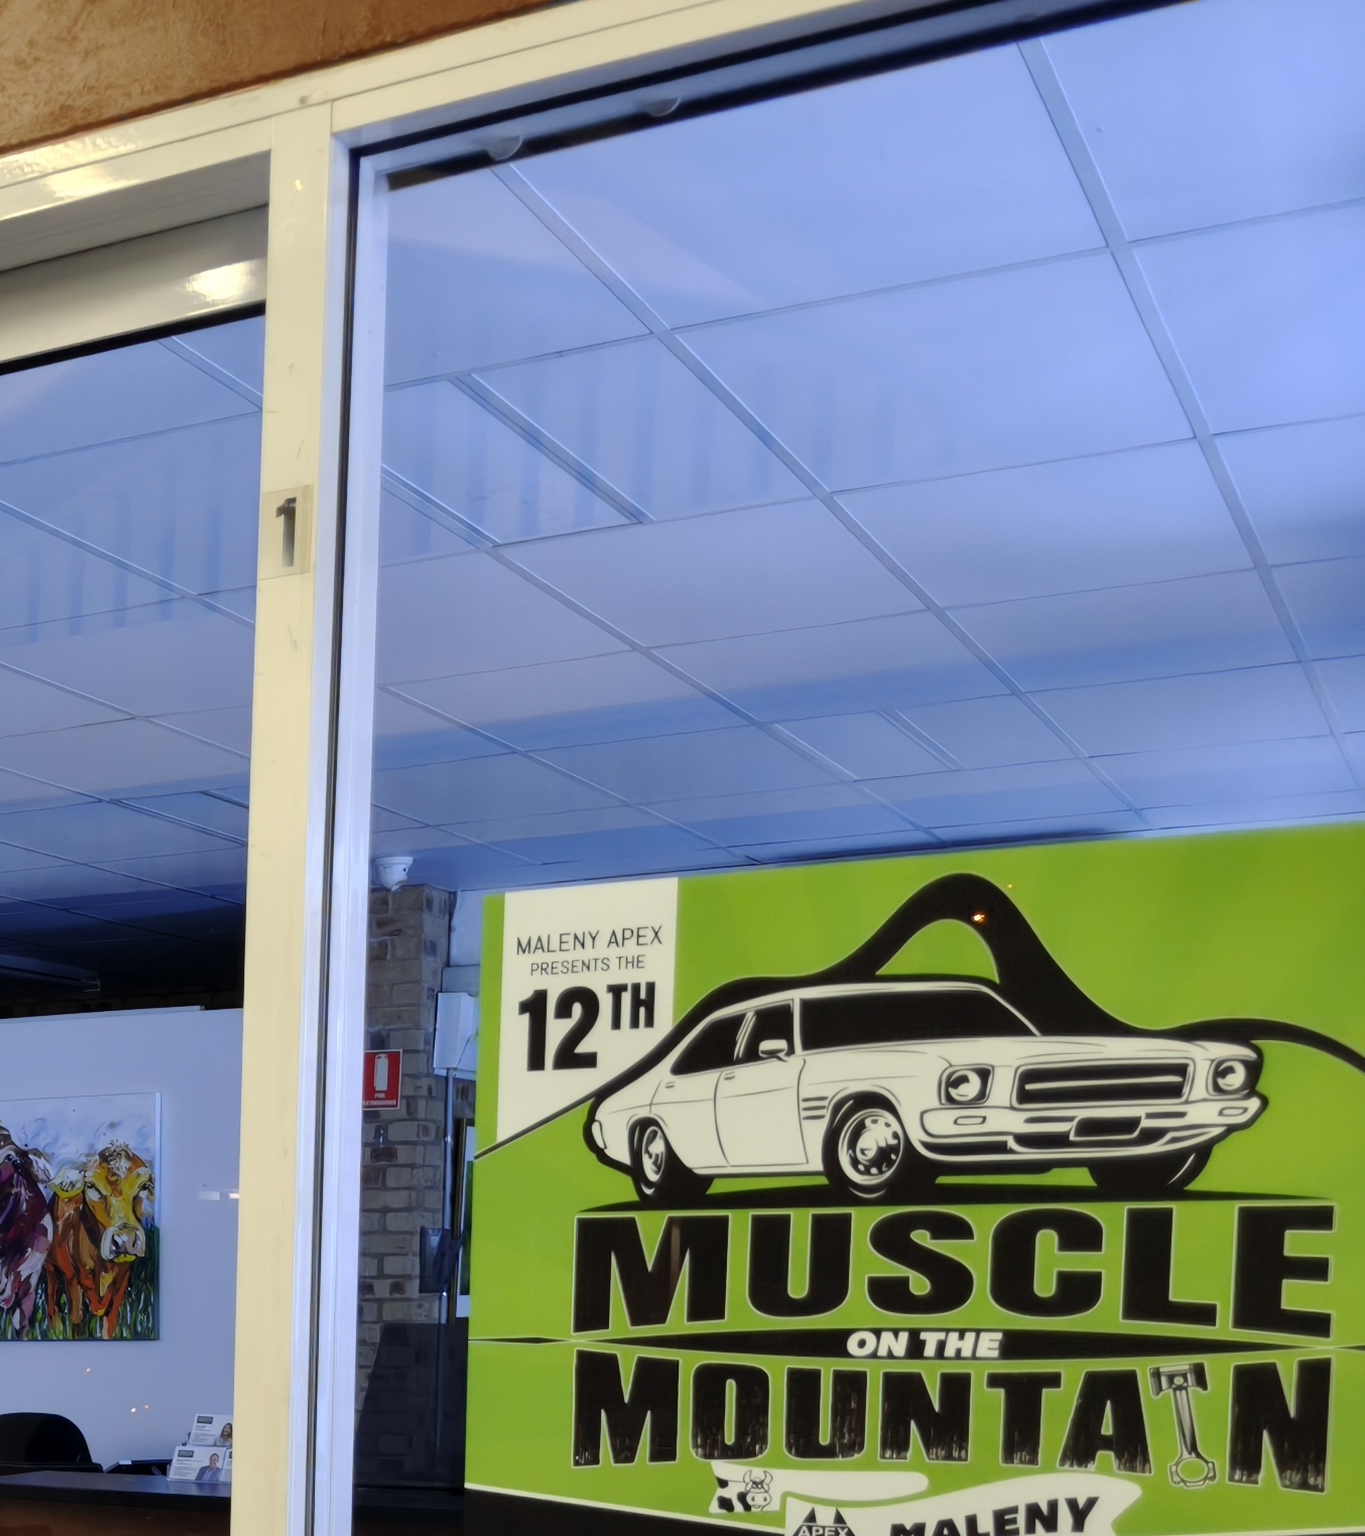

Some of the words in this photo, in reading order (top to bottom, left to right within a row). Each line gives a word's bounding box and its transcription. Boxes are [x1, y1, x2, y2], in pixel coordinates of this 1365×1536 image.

[517, 930, 599, 955] MALENY
[607, 925, 662, 948] APEX
[531, 957, 610, 976] PRESENTS
[616, 954, 645, 970] THE
[518, 981, 656, 1071] 12TH
[572, 1205, 1337, 1339] MUSCLE
[847, 1331, 915, 1359] ON
[919, 1332, 1004, 1361] THE
